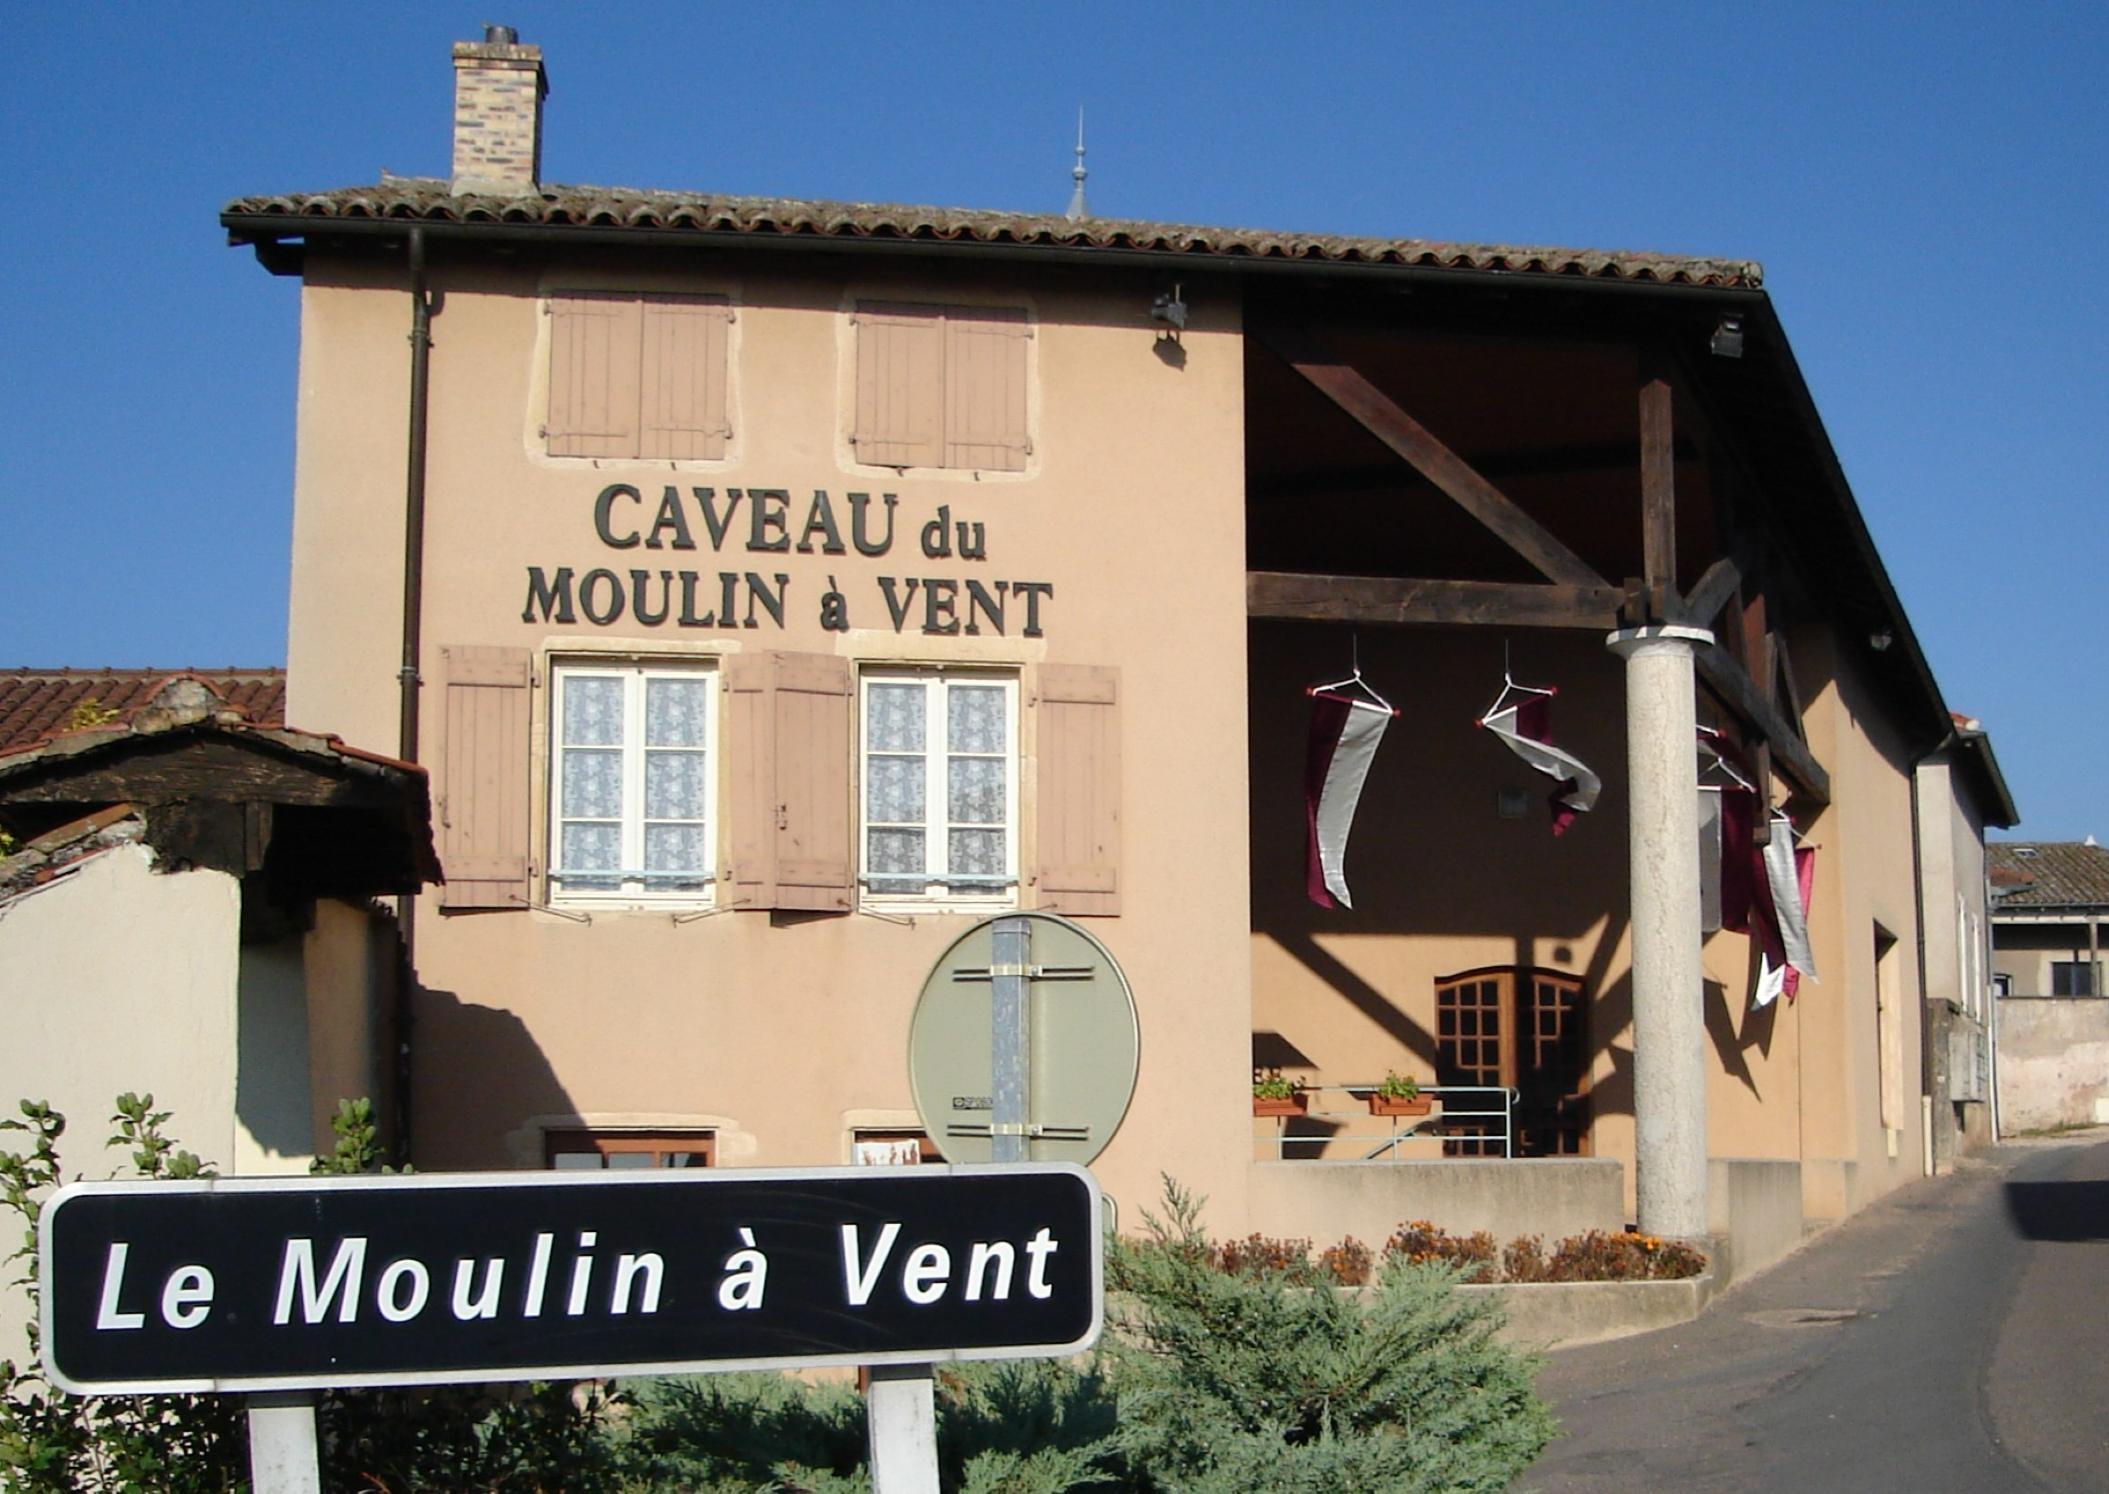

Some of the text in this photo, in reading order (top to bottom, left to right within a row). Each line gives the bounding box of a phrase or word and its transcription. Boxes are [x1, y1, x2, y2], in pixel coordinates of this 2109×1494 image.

[593, 483, 986, 561] CAVEAU du
[521, 567, 1053, 639] MOULIN à VENT
[96, 1223, 1058, 1331] Le Moulin à Vent
